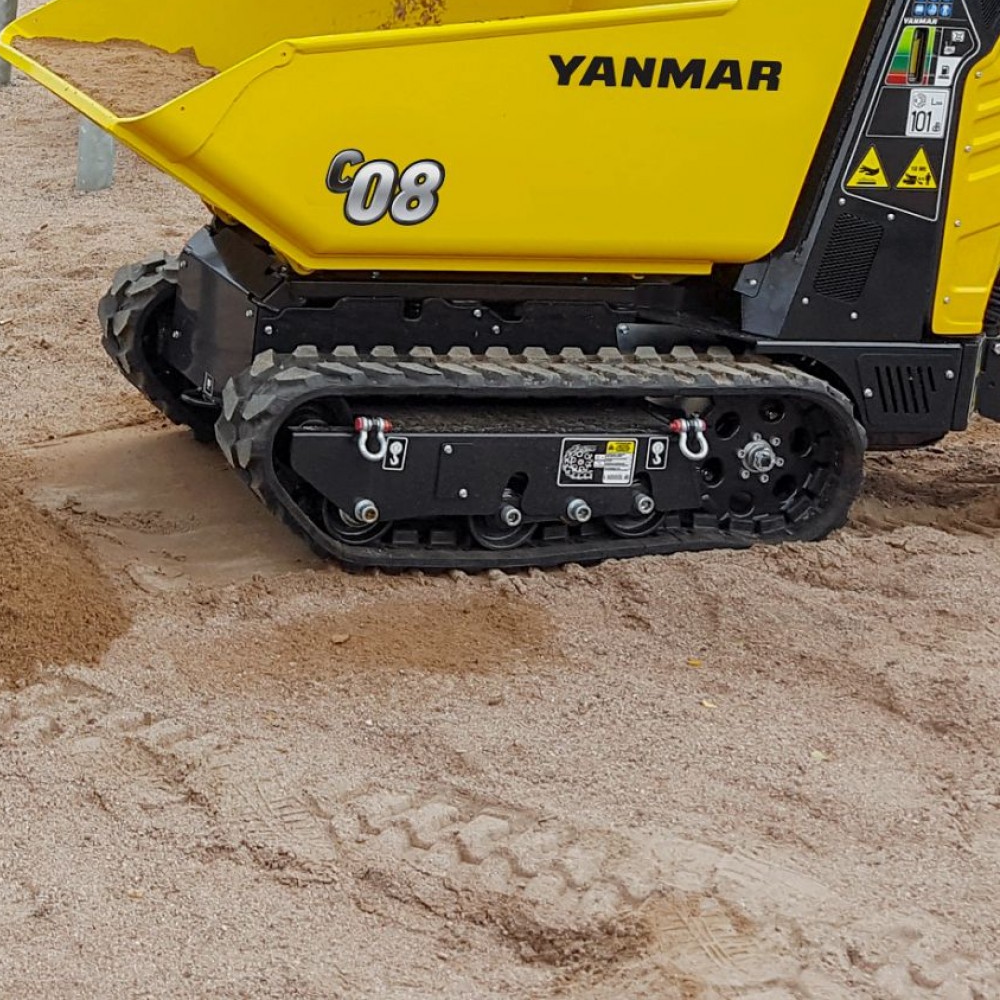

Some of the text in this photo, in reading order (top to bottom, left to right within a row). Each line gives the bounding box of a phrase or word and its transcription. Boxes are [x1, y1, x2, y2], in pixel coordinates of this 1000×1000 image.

[903, 17, 938, 25] YANMAR
[549, 55, 782, 91] YANMAR
[911, 110, 932, 132] 101
